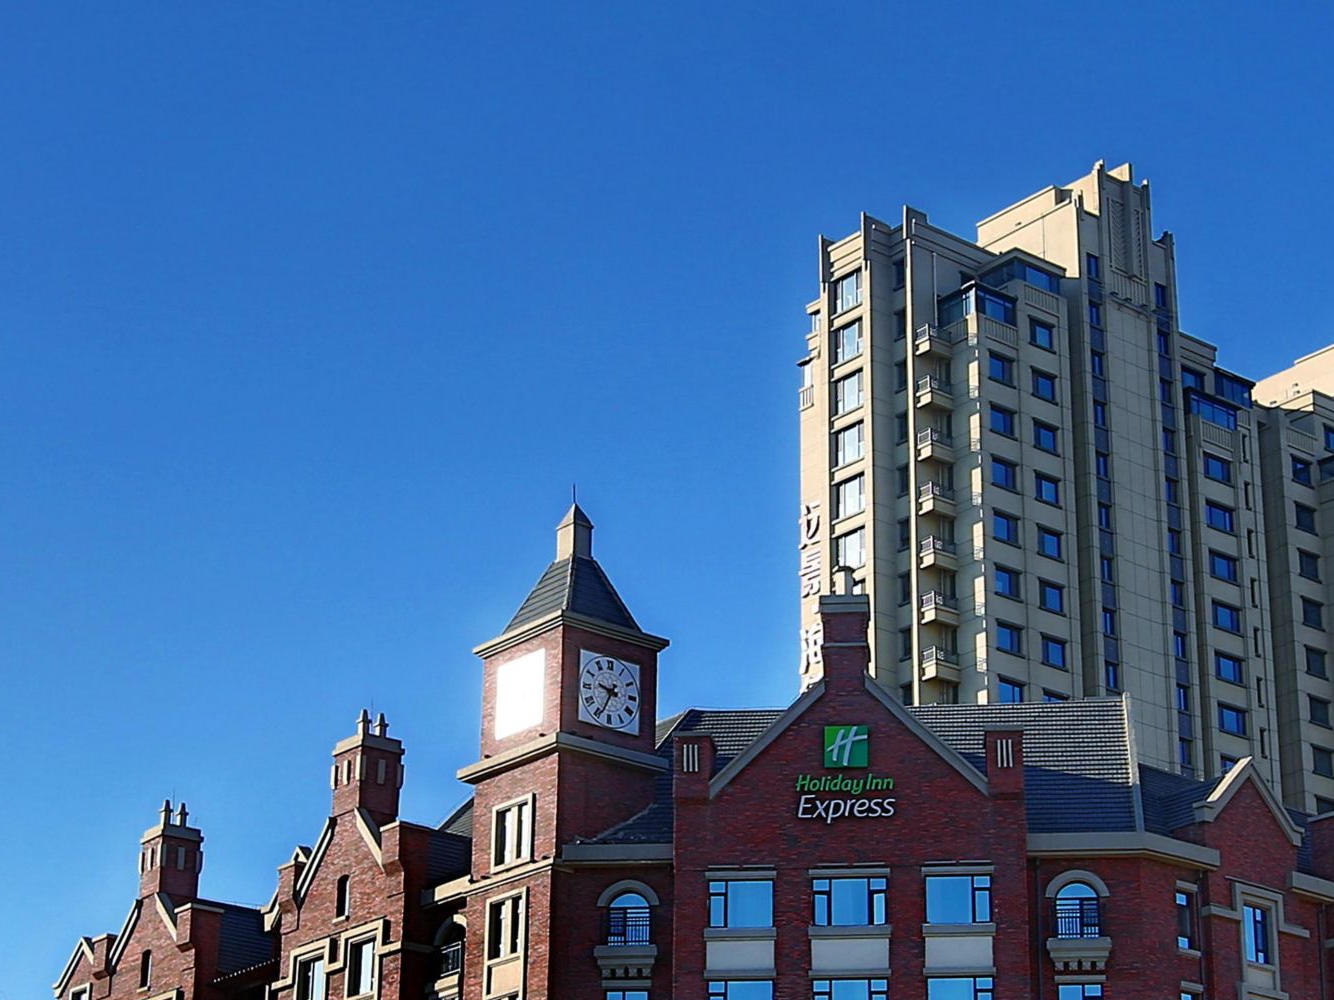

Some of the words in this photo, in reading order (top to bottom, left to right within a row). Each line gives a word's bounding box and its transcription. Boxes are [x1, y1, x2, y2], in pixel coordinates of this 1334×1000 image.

[795, 774, 864, 795] Holiday
[866, 773, 894, 790] Inn
[797, 794, 896, 824] Express
